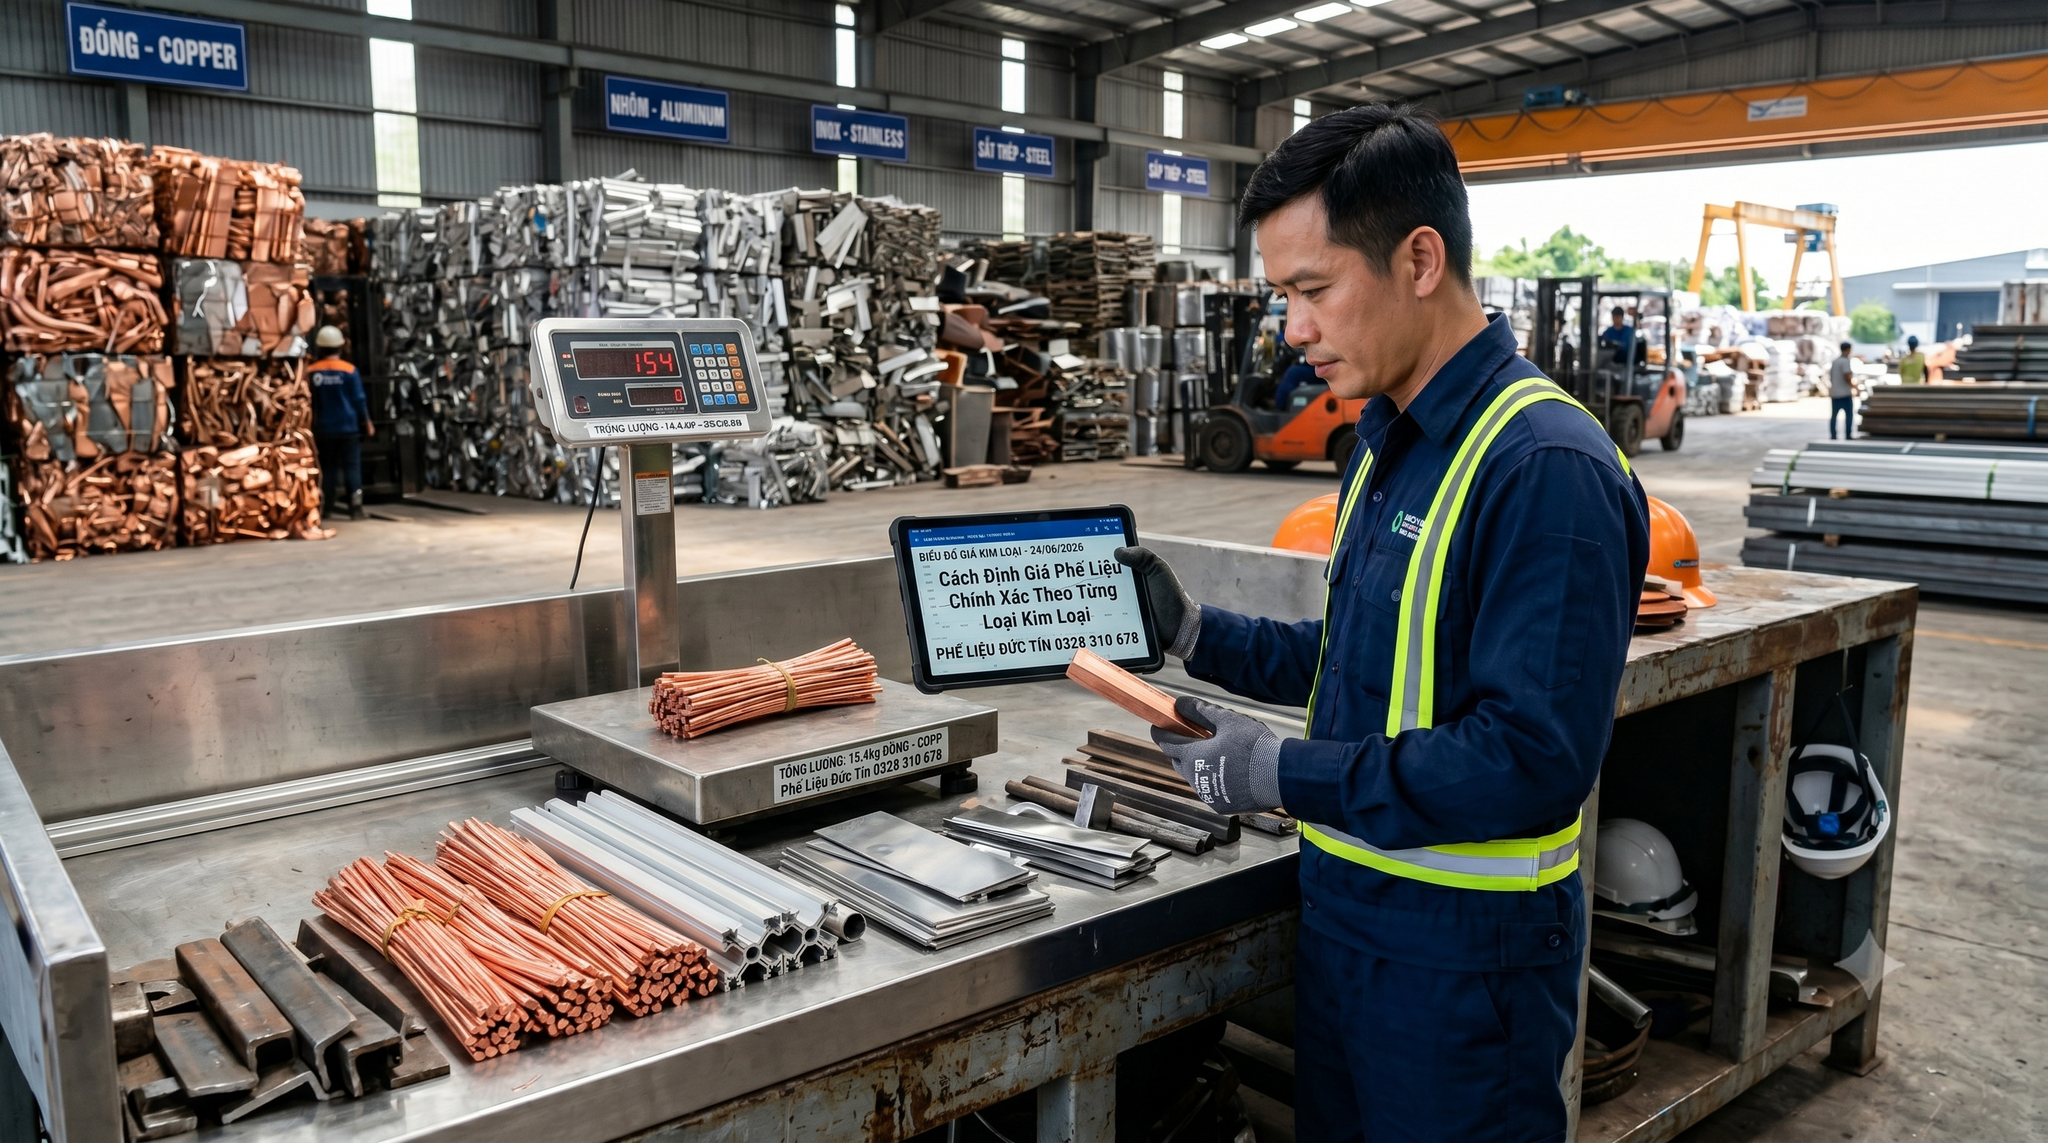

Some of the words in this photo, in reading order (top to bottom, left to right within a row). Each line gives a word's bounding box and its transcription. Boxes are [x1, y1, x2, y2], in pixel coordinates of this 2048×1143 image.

[158, 35, 238, 71] COPPER
[610, 91, 649, 119] NHÔM
[660, 100, 725, 128] ALUMINUM
[815, 120, 842, 141] INOX
[850, 124, 904, 149] STAINLESS
[1025, 146, 1052, 166] STEEL
[634, 351, 674, 375] 154
[960, 546, 977, 560] GIÁ
[979, 547, 998, 558] KIM
[1000, 546, 1022, 558] LOẠI
[1030, 542, 1084, 555] 24/06/2026
[939, 568, 980, 587] Cách
[983, 566, 1020, 586] Định
[1024, 563, 1050, 581] Giá
[1054, 560, 1085, 578] Phế
[1088, 559, 1122, 578] Liệu
[949, 590, 996, 609] Chính
[999, 588, 1030, 605] Xác
[1032, 586, 1073, 603] Theo
[1075, 583, 1118, 601] Từng
[982, 611, 1018, 631] Loại
[1021, 610, 1053, 626] Kim
[1056, 606, 1091, 626] Loại
[936, 642, 963, 660] PHẾ
[966, 641, 995, 660] LIỆU
[998, 638, 1027, 656] ĐỨC
[1028, 637, 1052, 652] TÍN
[1054, 635, 1086, 651] 0328
[1088, 633, 1113, 647] 310
[1116, 631, 1139, 645] 678
[848, 747, 880, 764] 15.4kg
[917, 733, 942, 748] COPP
[781, 778, 803, 798] Phế
[805, 776, 828, 792] Liệu
[830, 770, 852, 786] Đức
[873, 758, 900, 776] 0328
[902, 753, 921, 769] 310
[923, 748, 942, 764] 678
